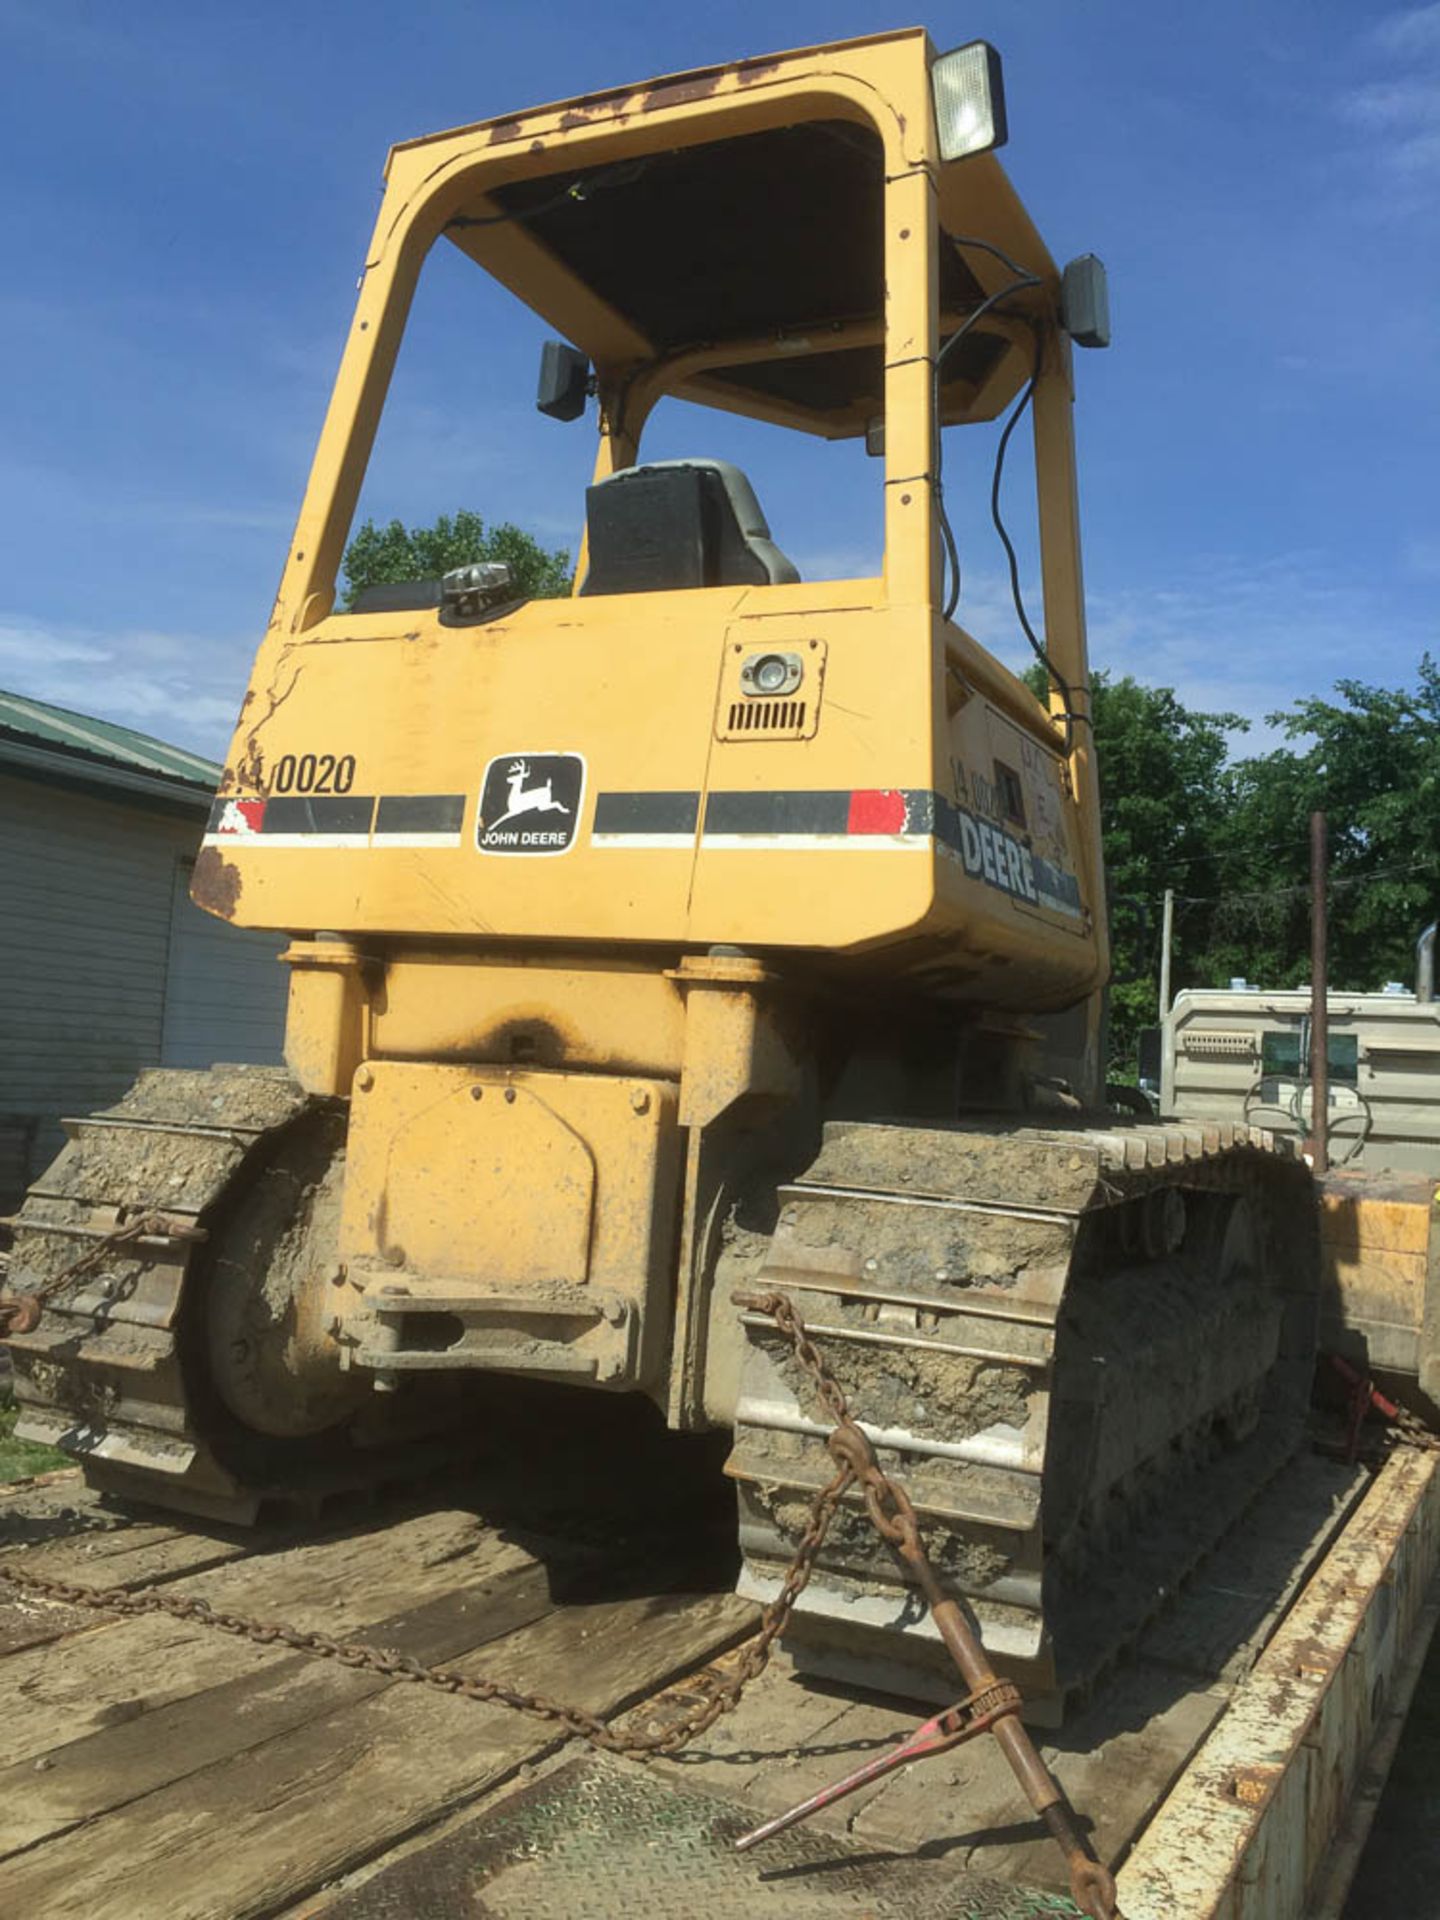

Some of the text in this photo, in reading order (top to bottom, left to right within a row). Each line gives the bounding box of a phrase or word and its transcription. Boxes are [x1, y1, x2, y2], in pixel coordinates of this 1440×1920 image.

[481, 832, 567, 845] JOHN DEERE
[959, 812, 1038, 901] DEERE
